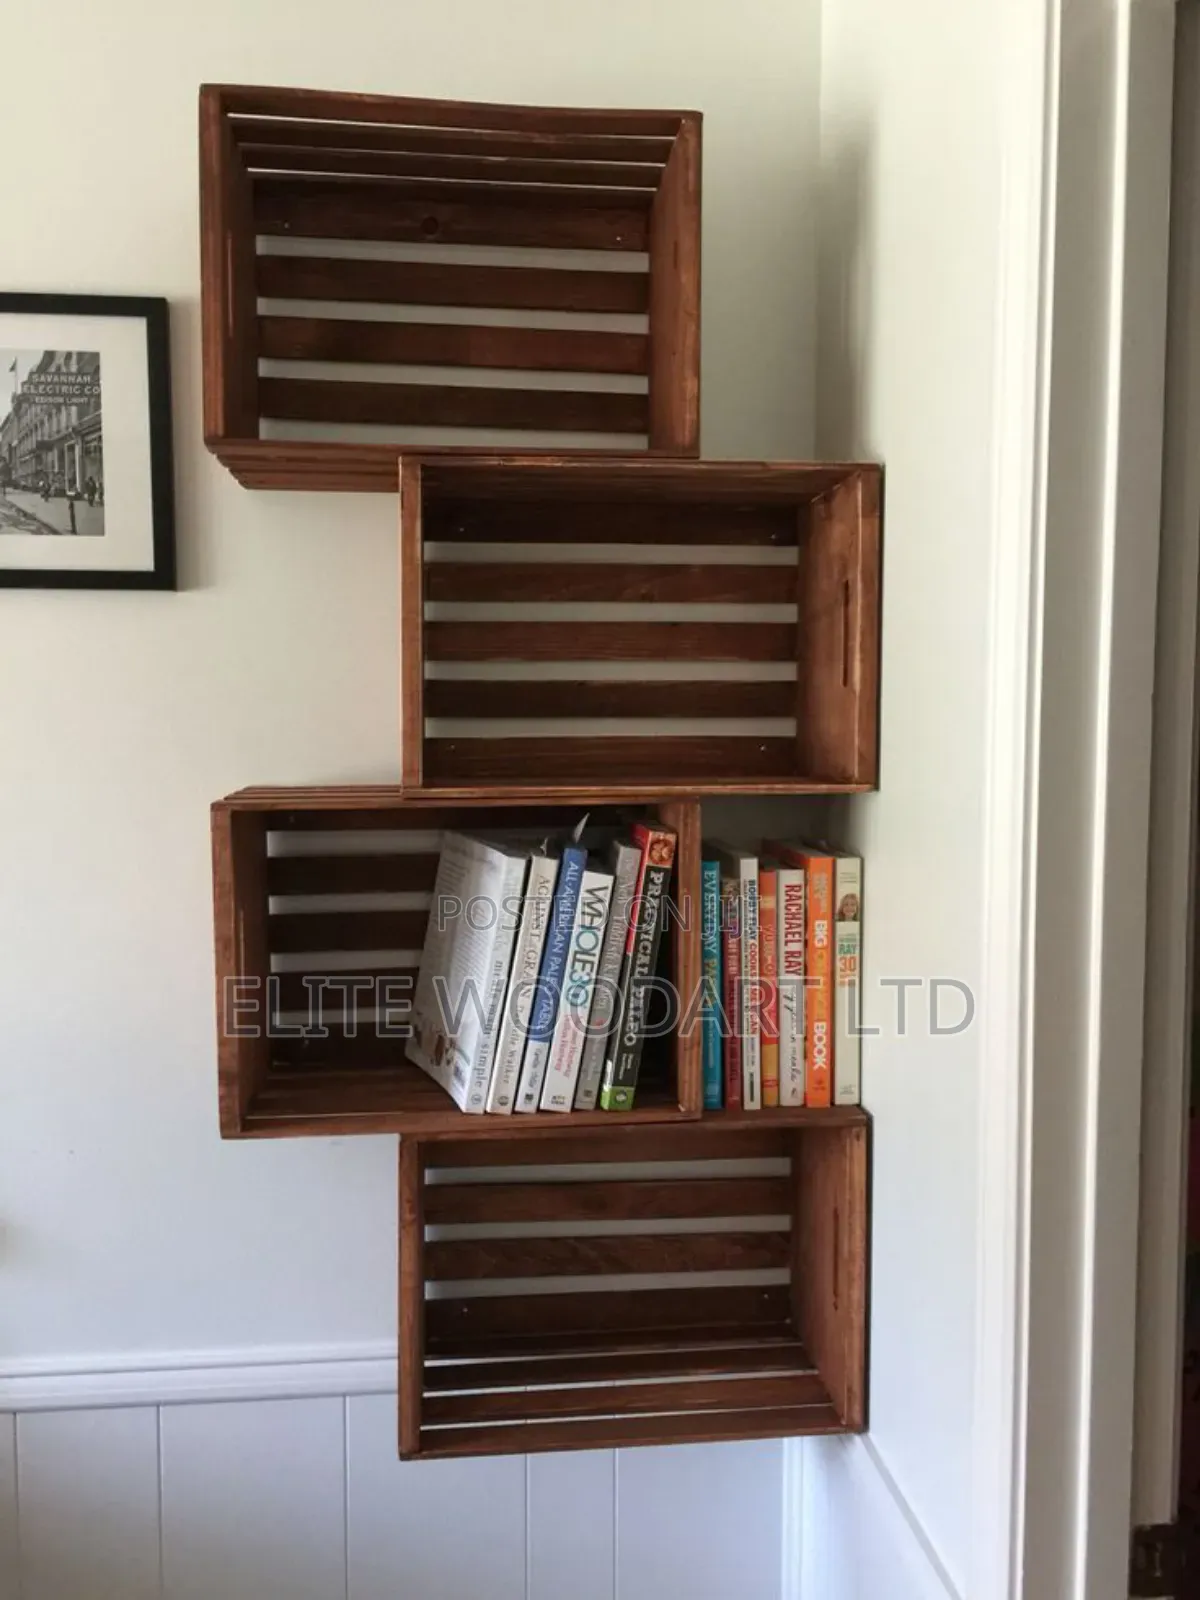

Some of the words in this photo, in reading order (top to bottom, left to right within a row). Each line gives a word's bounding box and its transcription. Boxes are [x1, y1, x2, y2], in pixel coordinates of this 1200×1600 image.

[22, 383, 81, 394] ELECTRIC
[32, 373, 91, 384] SAVANNAH
[703, 870, 716, 952] EVERYDAY
[748, 879, 756, 913] BOBBY
[784, 884, 801, 946] RACHAEL
[564, 882, 608, 1008] WHOLE30
[633, 870, 664, 977] PRACTICAL
[814, 920, 827, 947] BIG
[518, 949, 538, 998] GRAIN
[542, 955, 560, 998] PALEO
[748, 942, 757, 977] COOKS
[784, 950, 801, 976] RAY
[623, 986, 645, 1046] PALEO
[469, 1042, 491, 1088] simple
[813, 1021, 825, 1069] BOOK
